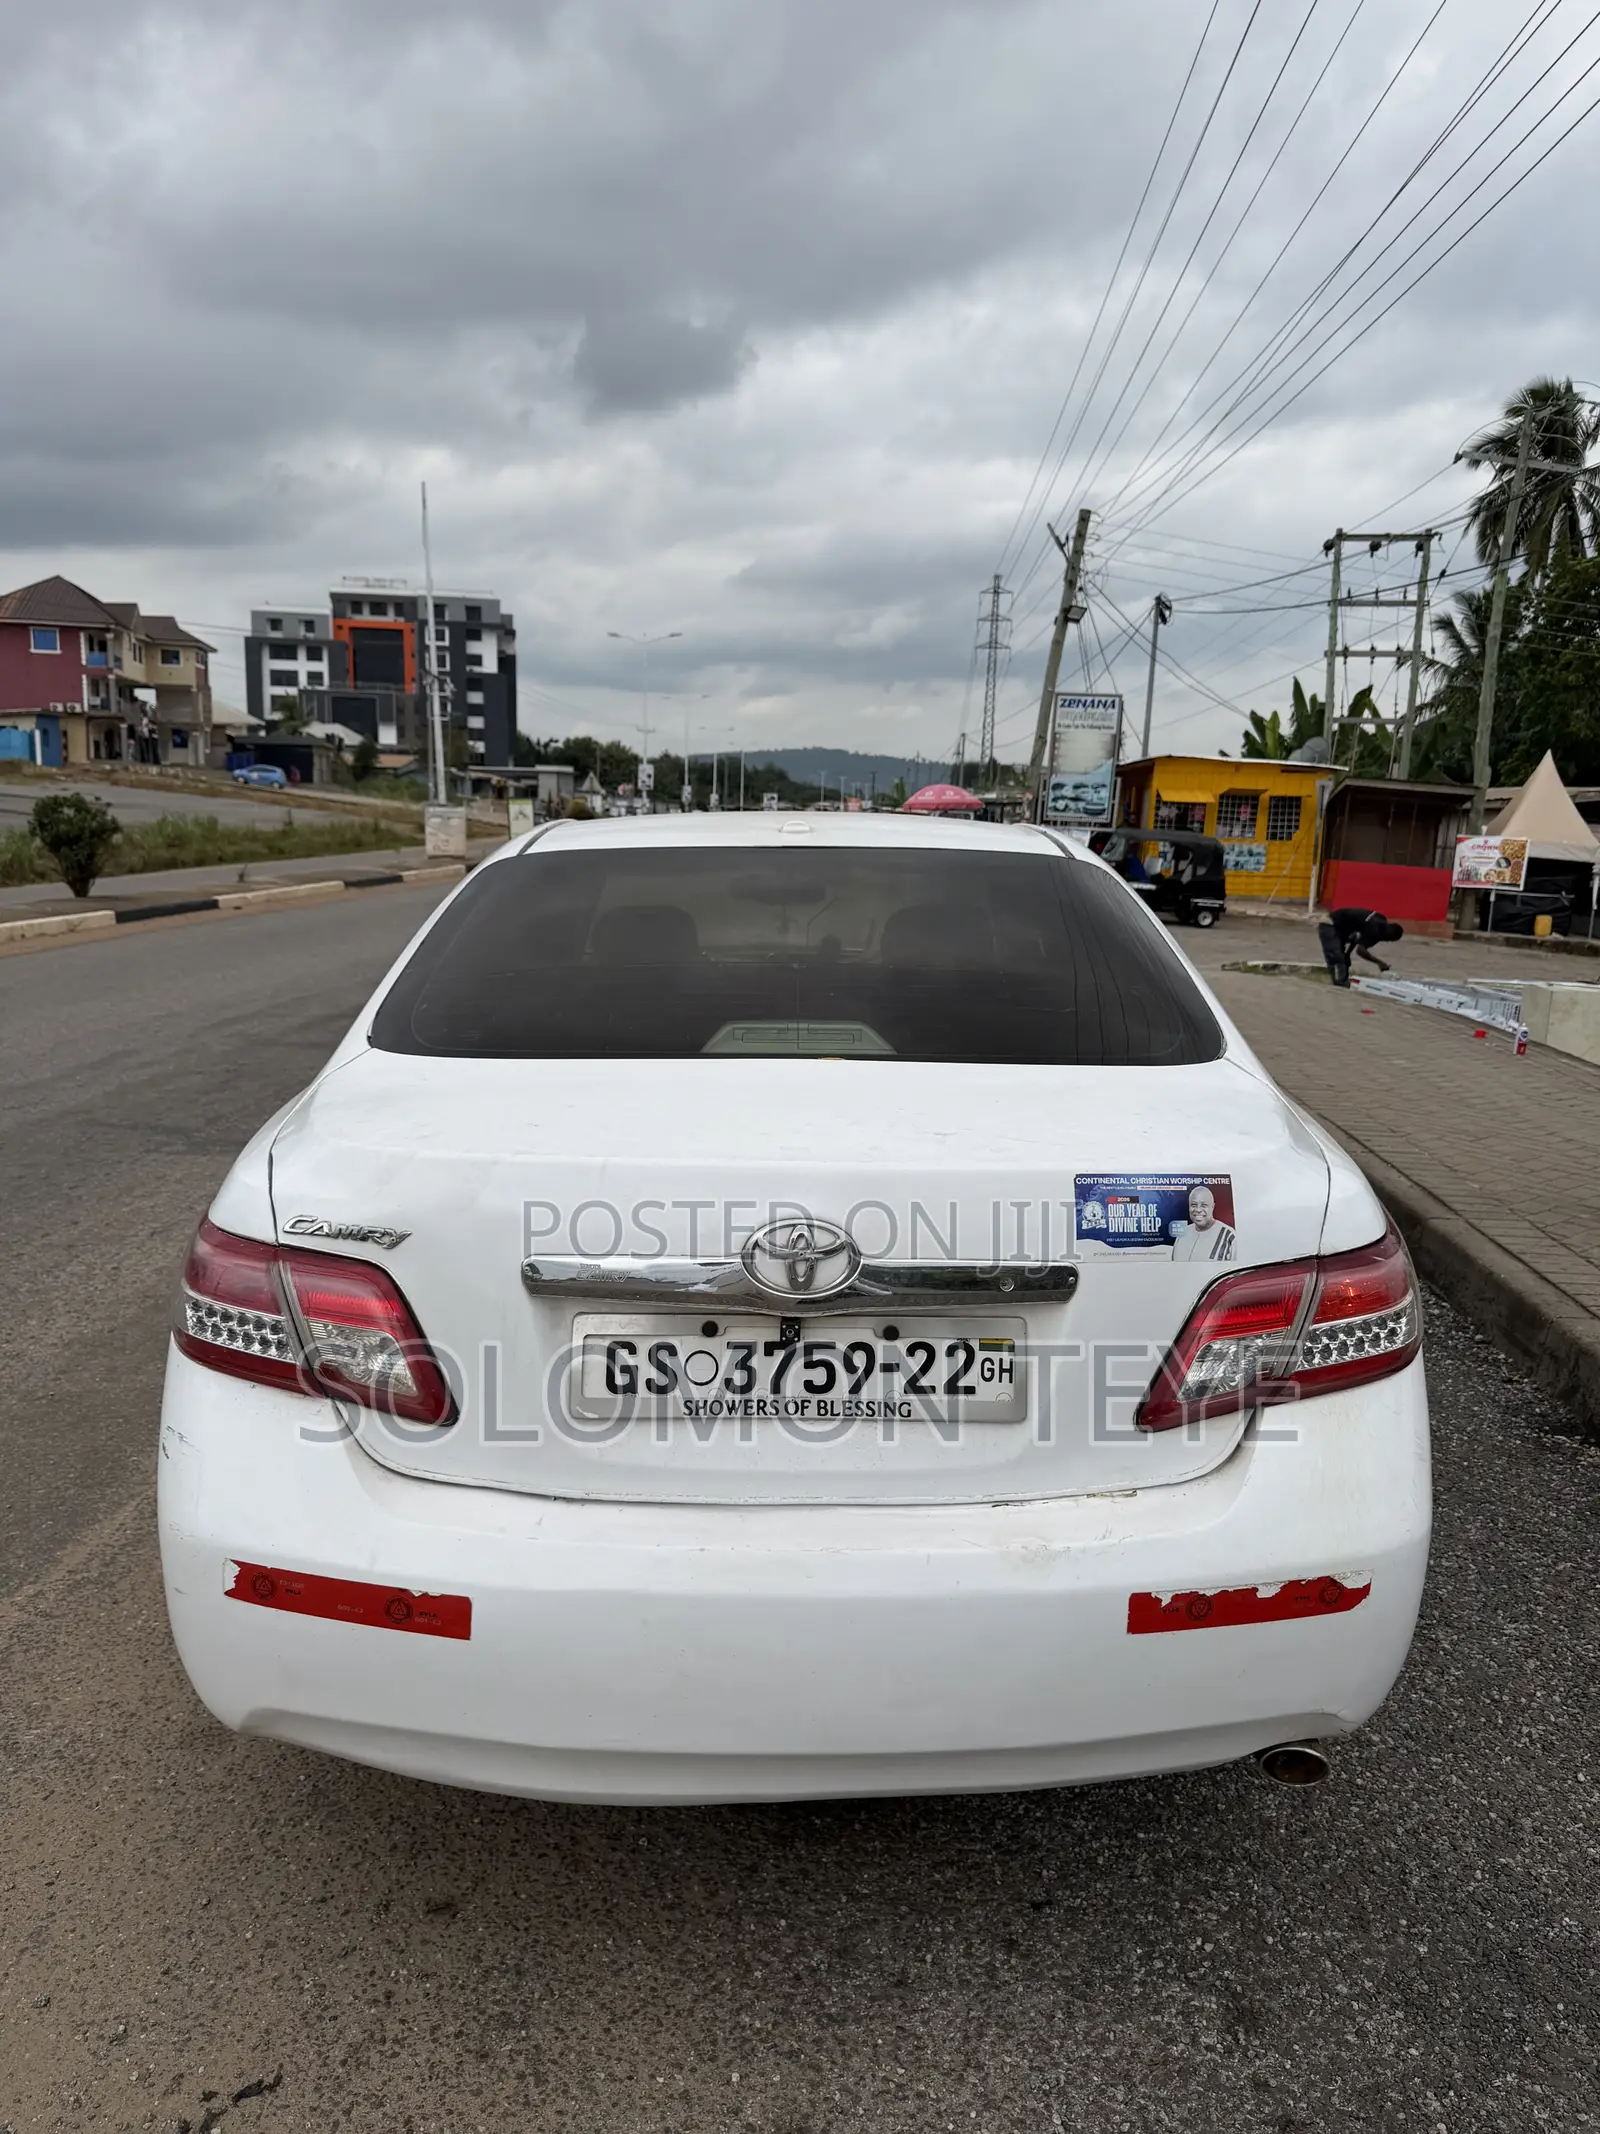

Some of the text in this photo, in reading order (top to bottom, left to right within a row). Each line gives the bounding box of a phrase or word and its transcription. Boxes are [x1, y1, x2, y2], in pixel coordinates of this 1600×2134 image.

[1076, 1177, 1129, 1185] CONTINENTAL
[1131, 1177, 1169, 1185] CHRISTIAN
[1170, 1177, 1202, 1185] WORSHIP
[1108, 1204, 1158, 1217] OUR YEAR OF
[1109, 1218, 1139, 1232] DIVINE
[1141, 1217, 1161, 1232] HELP
[605, 1340, 976, 1395] GS 3759-22
[980, 1357, 1013, 1384] GH
[683, 1399, 912, 1418] SHOWERS OF BLESSING
